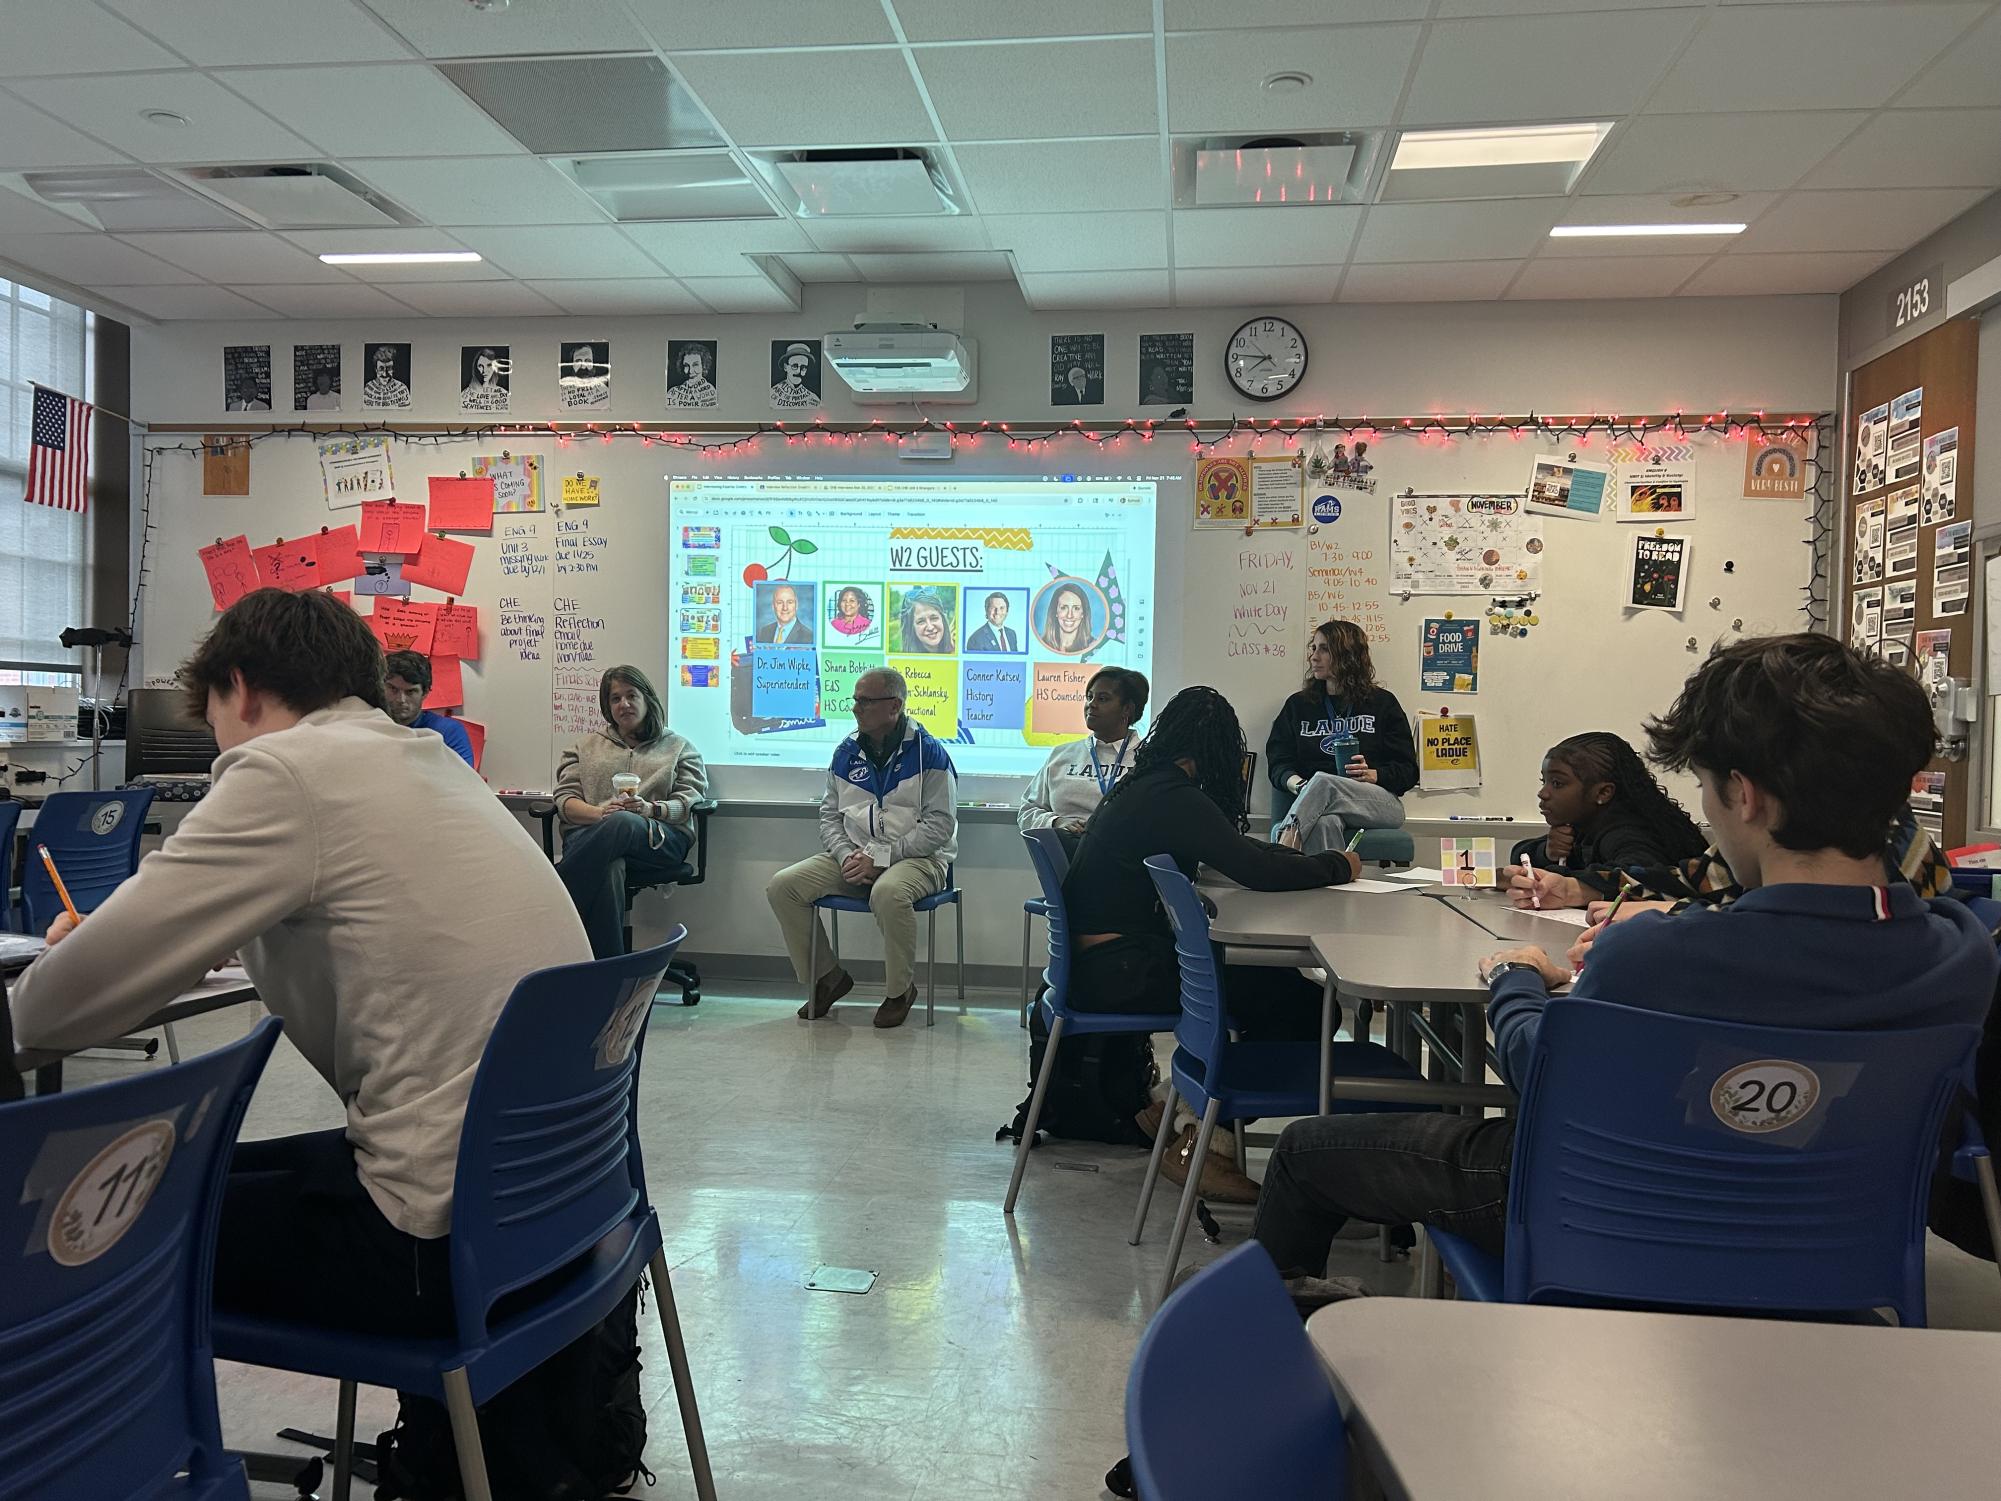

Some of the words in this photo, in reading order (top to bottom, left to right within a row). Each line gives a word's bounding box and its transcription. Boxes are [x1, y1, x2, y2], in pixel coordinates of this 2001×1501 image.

[1896, 278, 1929, 327] 2153
[1249, 326, 1257, 337] 11
[1263, 321, 1274, 332] 12
[1281, 326, 1285, 337] 1
[1235, 337, 1246, 348] 10
[1290, 338, 1298, 349] 2
[1054, 345, 1068, 354] ONE
[1052, 354, 1082, 363] CREATIVE
[1231, 352, 1239, 363] 9
[1294, 353, 1301, 364] 3
[1234, 367, 1242, 378] 8
[1288, 368, 1296, 378] 4
[1246, 379, 1254, 391] 7
[1261, 383, 1269, 394] 6
[1276, 380, 1283, 391] 5
[567, 399, 589, 407] BOOK
[490, 471, 513, 480] WHAT
[500, 479, 525, 491] COMING
[576, 479, 587, 487] WE
[1471, 499, 1512, 511] NOVEMBER
[504, 526, 526, 536] ENG
[529, 525, 536, 535] 9
[557, 521, 579, 532] ENG
[583, 519, 589, 529] 9
[521, 542, 529, 552] 3
[555, 536, 577, 549] Final
[583, 536, 608, 549] Essay
[1638, 540, 1682, 552] FREEDOM
[500, 553, 533, 565] missing
[555, 551, 571, 561] due
[891, 546, 912, 567] W2
[917, 546, 983, 569] GUESTS:
[1239, 550, 1294, 570] FRIDAY,
[1638, 550, 1650, 559] TO
[1651, 551, 1680, 562] READ
[503, 565, 519, 575] due
[520, 564, 530, 578] by
[557, 563, 567, 574] by
[1240, 582, 1258, 598] NOV
[1262, 580, 1275, 594] 21
[499, 597, 521, 609] CHE
[553, 597, 581, 612] CHE
[1233, 606, 1262, 620] White
[1265, 603, 1288, 621] Day
[500, 615, 512, 625] Be
[514, 614, 545, 625] thinking
[555, 616, 605, 630] Reflection
[500, 628, 522, 637] about
[525, 626, 545, 639] final
[554, 629, 581, 641] email
[1439, 632, 1462, 642] FOOD
[509, 639, 539, 650] project
[556, 639, 579, 651] home
[579, 640, 595, 650] due
[1228, 640, 1261, 657] CLASS
[1263, 644, 1286, 657] #38
[1439, 643, 1463, 653] DRIVE
[757, 656, 768, 670] Dr.
[770, 657, 785, 670] Jim
[788, 657, 811, 676] Wipke,
[824, 659, 847, 673] Shana
[905, 666, 932, 679] Rebecca
[966, 668, 993, 682] Conner
[996, 669, 1022, 684] Katsev,
[1037, 670, 1061, 683] Lauren
[1063, 670, 1086, 684] Fisher,
[756, 676, 809, 694] Superintendent
[824, 679, 840, 692] EdS
[966, 690, 994, 707] History
[1036, 689, 1049, 701] HS
[1050, 689, 1087, 702] Counselor
[824, 699, 837, 712] HS
[906, 704, 936, 716] ructional
[966, 709, 994, 721] Teacher
[1300, 714, 1376, 737] LADUE
[1439, 724, 1458, 733] HATE
[1426, 737, 1439, 747] NO
[1441, 736, 1472, 746] PLACE
[1436, 747, 1468, 758] LADUE
[1067, 764, 1134, 778] LADU
[101, 809, 118, 825] 15
[1460, 849, 1475, 871] 1
[1731, 1080, 1797, 1113] 20
[93, 1155, 148, 1227] 11
